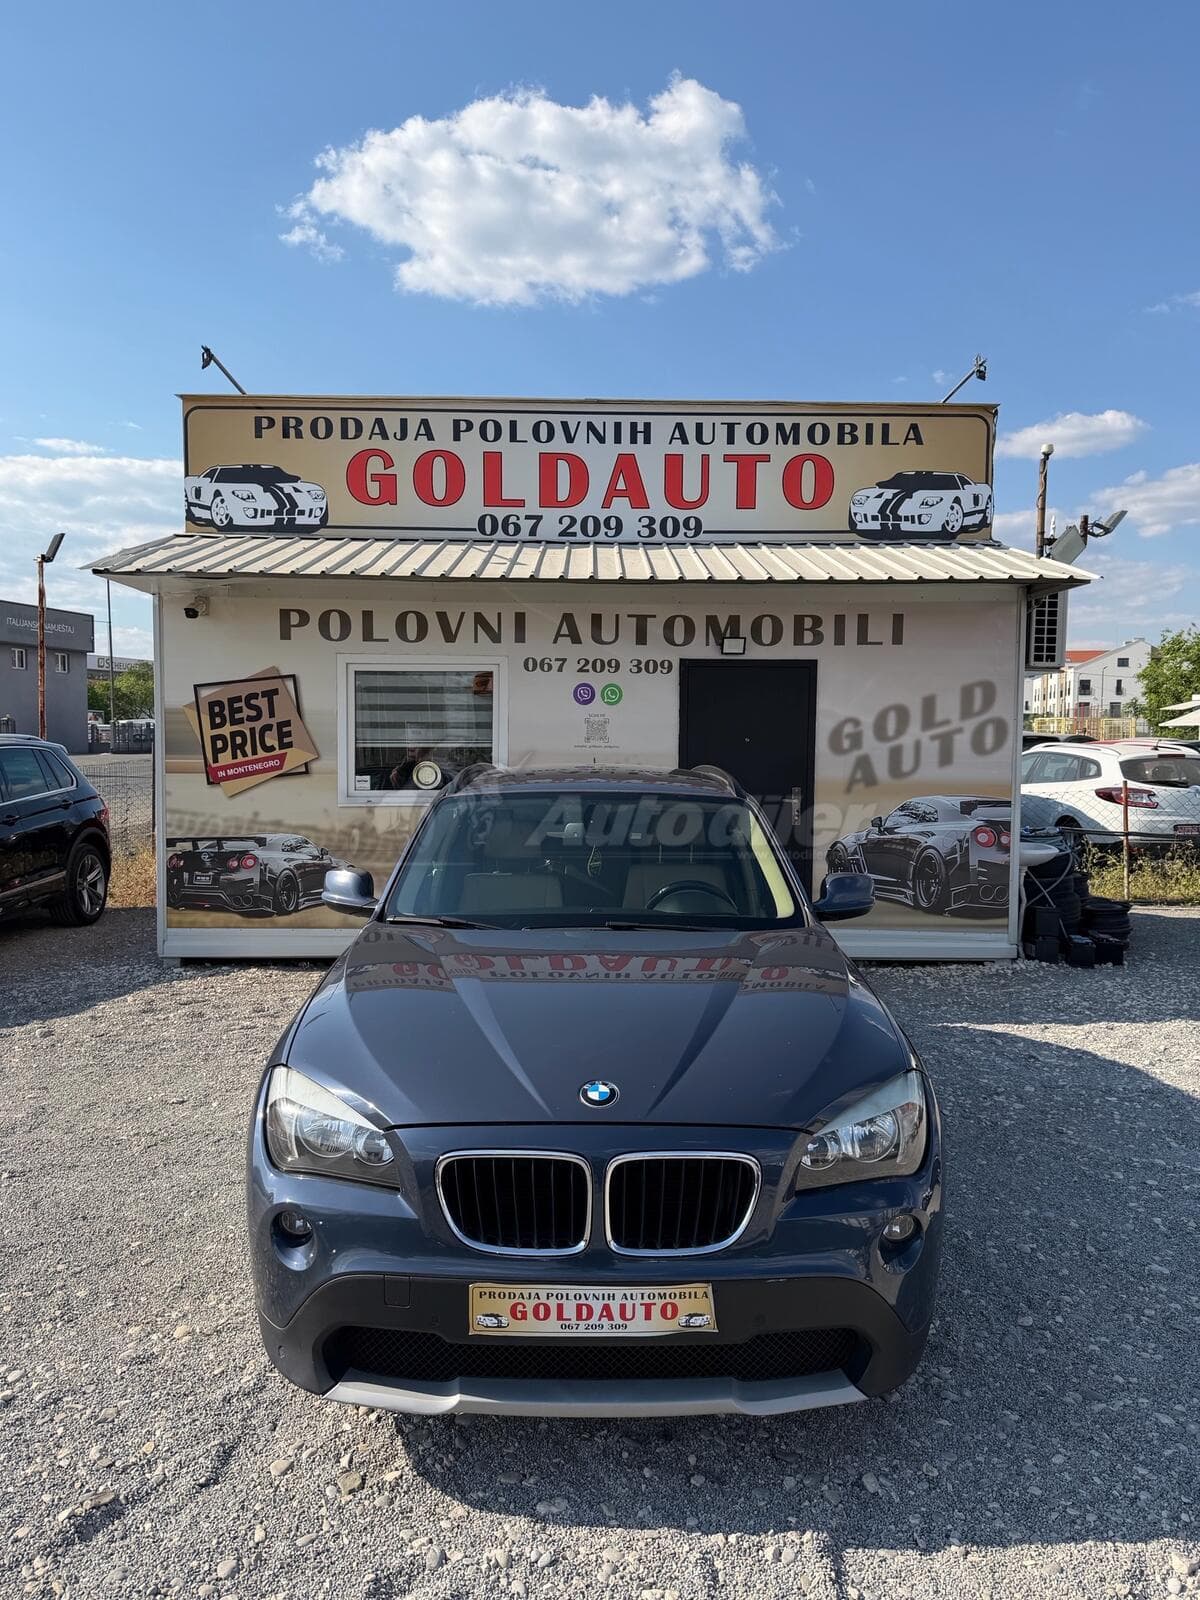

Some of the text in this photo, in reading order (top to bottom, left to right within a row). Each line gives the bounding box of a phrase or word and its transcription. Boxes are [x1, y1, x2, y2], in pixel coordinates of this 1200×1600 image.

[254, 415, 925, 446] PRODAJA POLOVNIH AUTOMOBILA
[346, 447, 835, 511] GOLDAUTO
[476, 513, 704, 539] 067 209 309
[278, 607, 905, 647] POLOVNI AUTOMOBILI
[523, 656, 674, 675] 067 209 309
[207, 687, 280, 731] BEST
[827, 679, 998, 757] GOLD
[210, 719, 294, 764] PRICE
[846, 716, 1010, 794] AUTO
[217, 759, 281, 778] IN MONTENEGRO
[479, 1290, 709, 1301] PRODAJA POLOVNIH AUTOMOBILA
[509, 1301, 679, 1322] GOLDAUTO
[560, 1323, 628, 1331] 067 209 309
